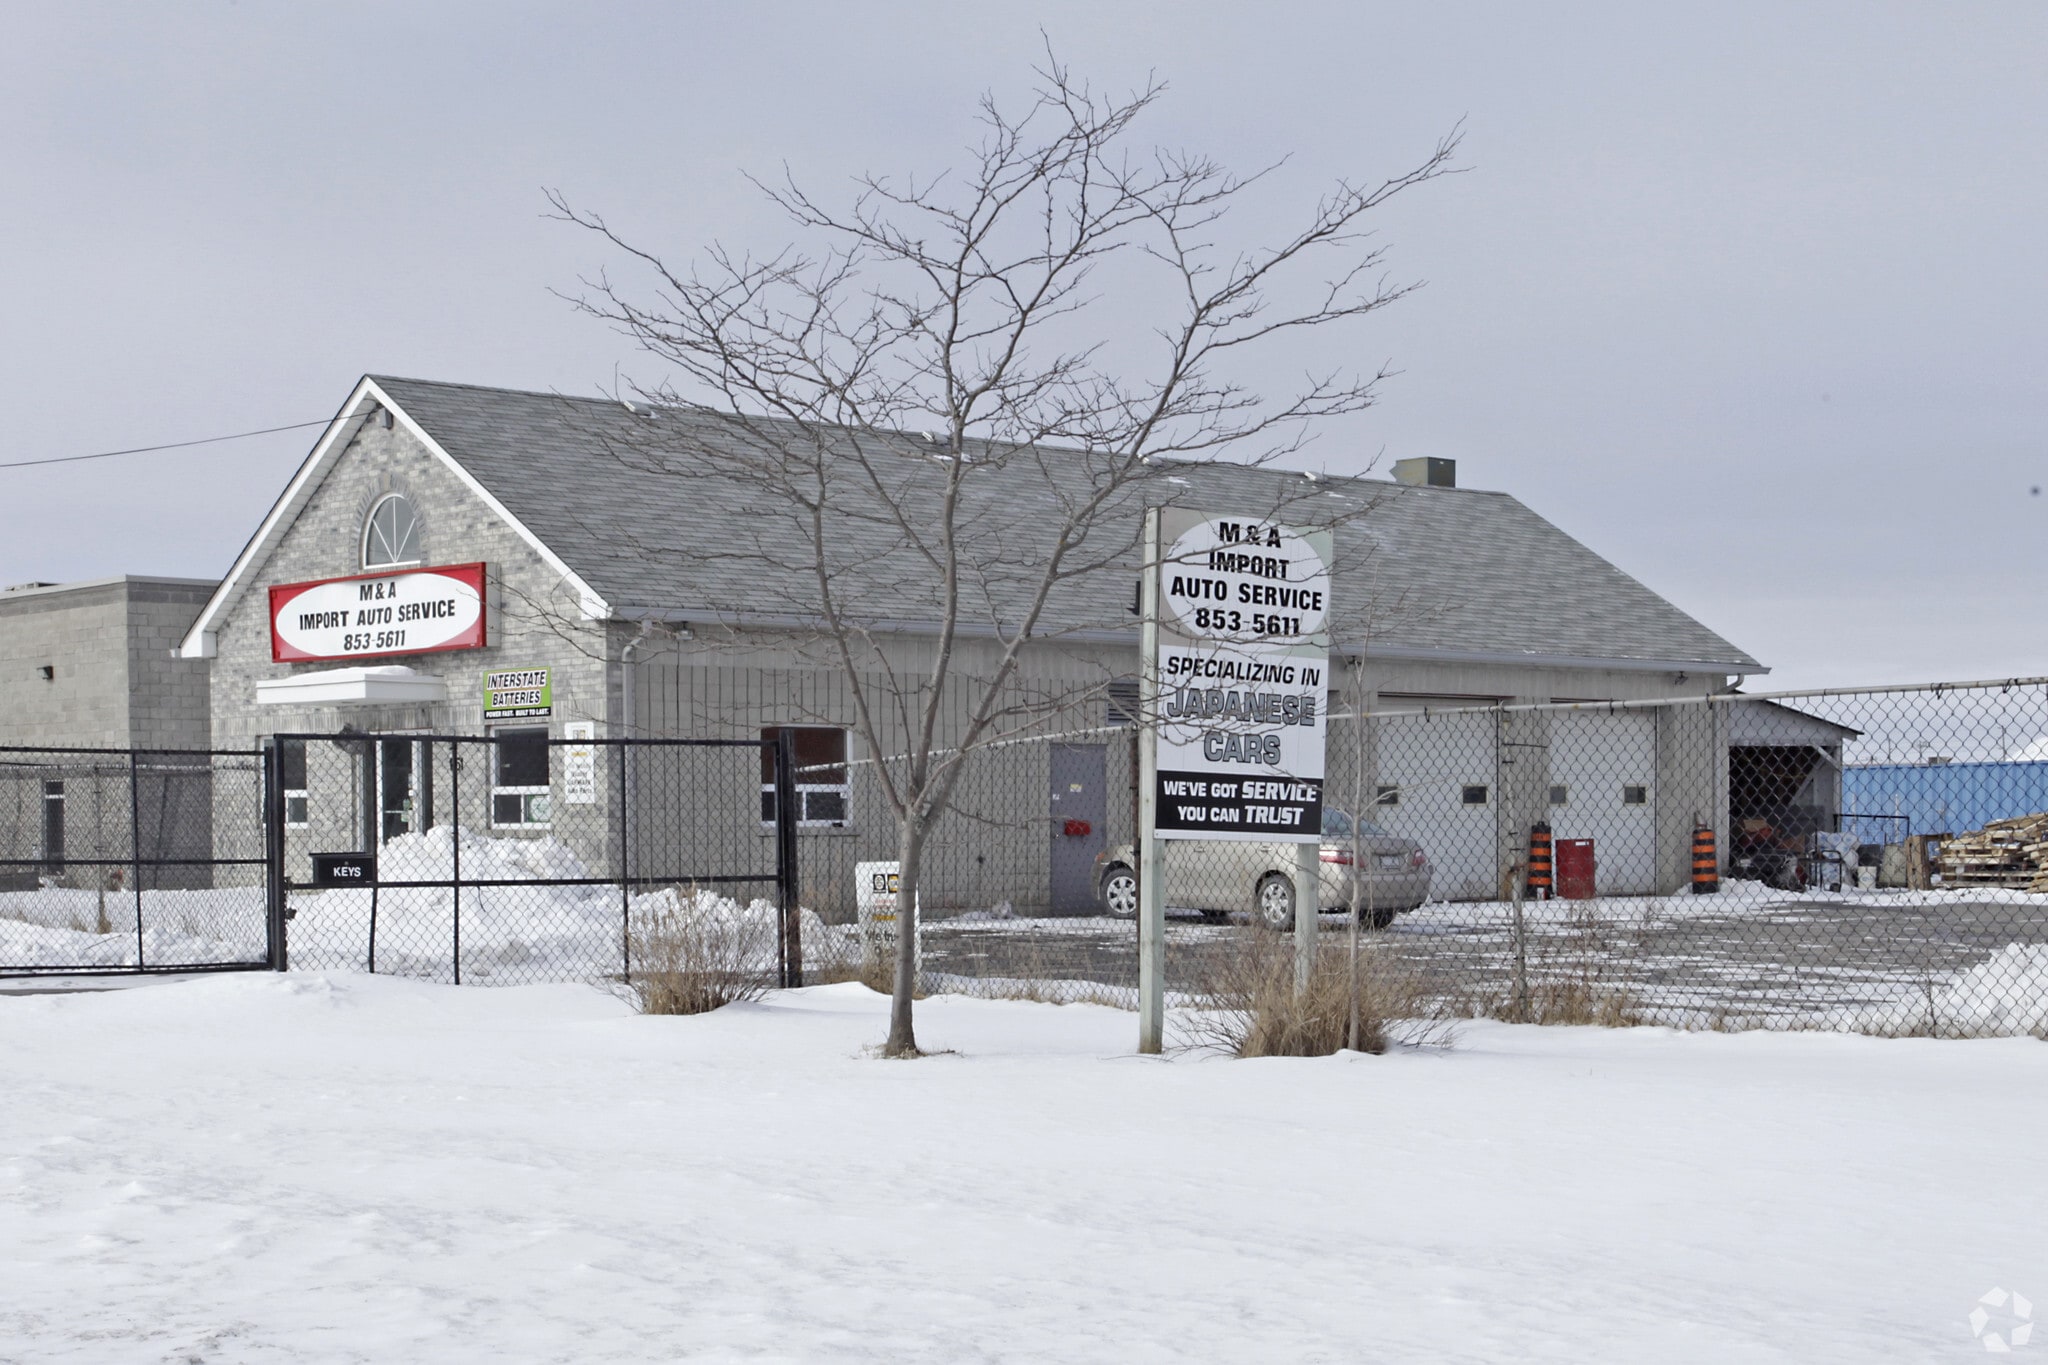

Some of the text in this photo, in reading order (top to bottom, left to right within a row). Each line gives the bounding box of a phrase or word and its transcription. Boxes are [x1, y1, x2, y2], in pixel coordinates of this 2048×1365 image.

[1219, 522, 1281, 548] M & A
[1209, 551, 1290, 579] IMPORT
[360, 582, 397, 601] M & A
[1171, 576, 1322, 611] AUTO SERVICE
[300, 599, 455, 630] IMPORT AUTO SERVICE
[1195, 608, 1300, 637] 853-5611
[344, 630, 406, 651] 853-5611
[487, 671, 546, 689] INTERSTATE
[1167, 656, 1320, 686] SPECIALIZING IN
[492, 691, 540, 706] BATTERIES
[1166, 687, 1316, 727] JAPANESE
[1203, 731, 1281, 765] CARS
[1163, 780, 1317, 802] WE'VE GOT SERVICE
[1177, 805, 1304, 825] YOU CAN TRUST
[333, 866, 361, 877] KEYS
